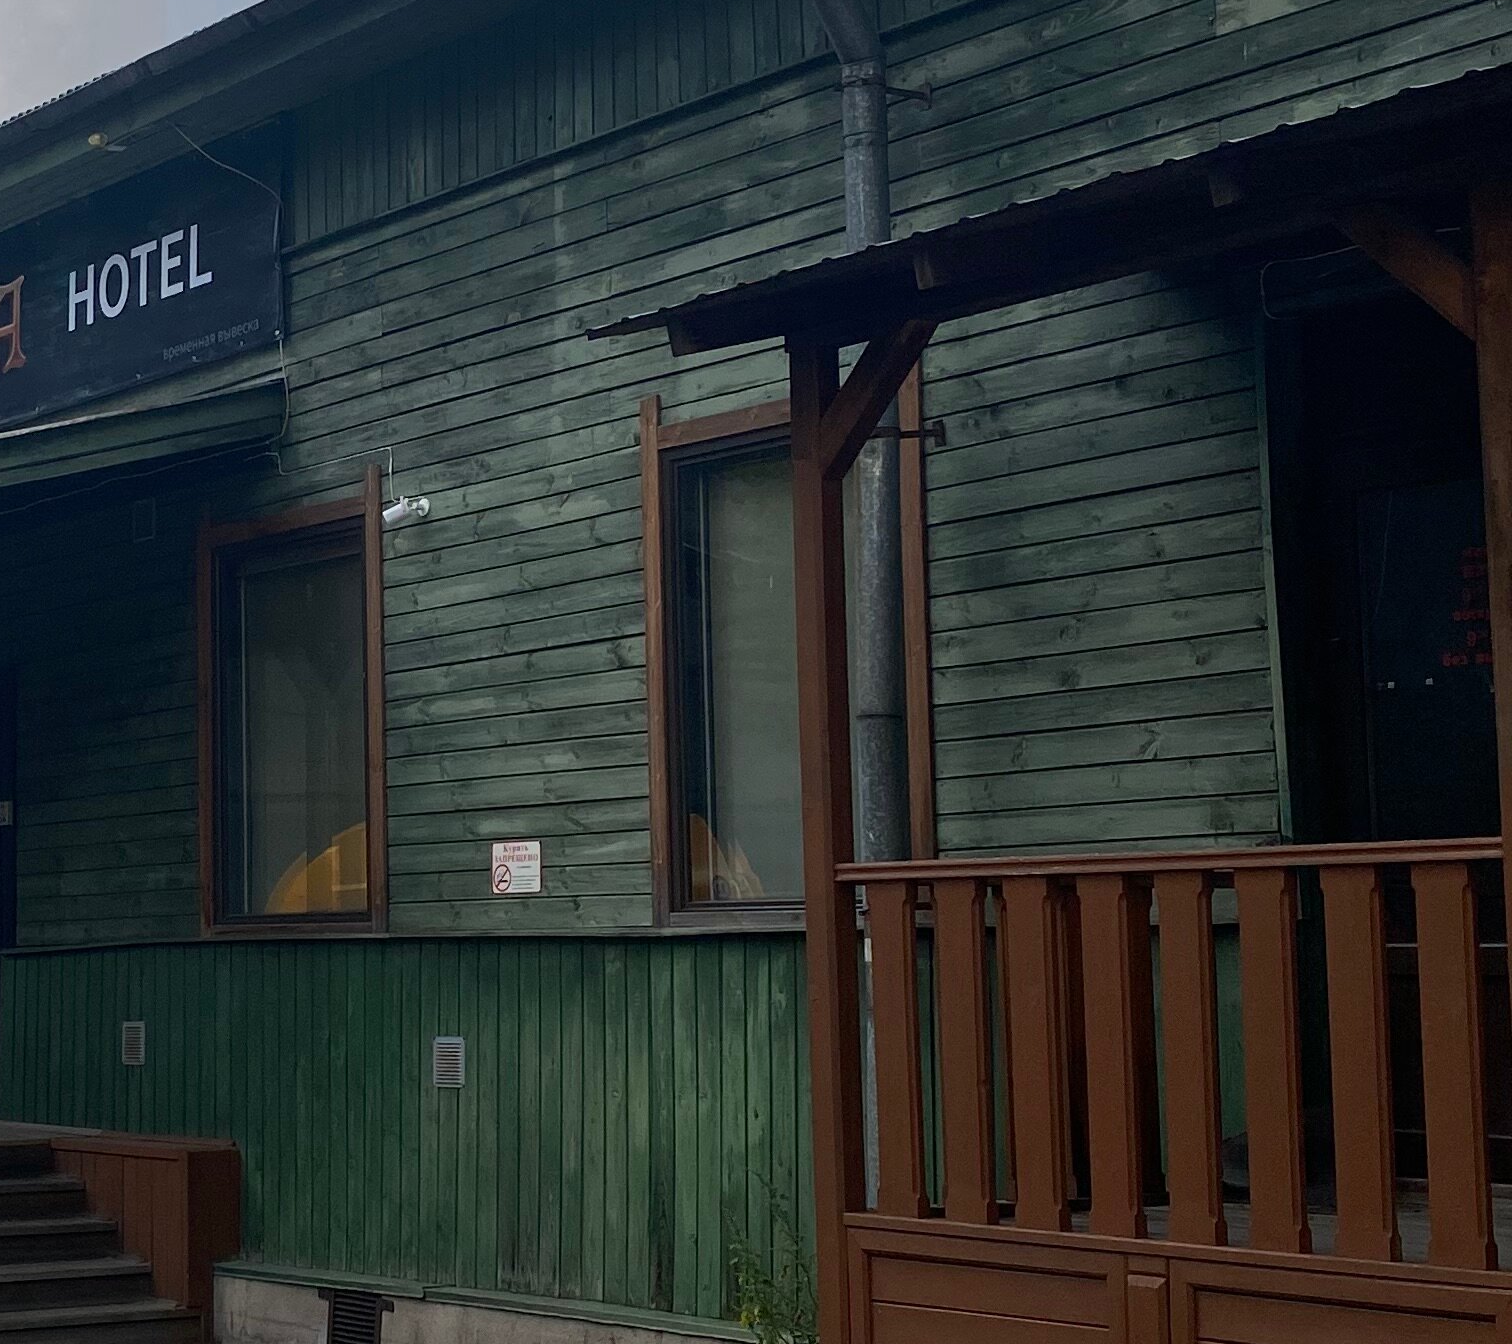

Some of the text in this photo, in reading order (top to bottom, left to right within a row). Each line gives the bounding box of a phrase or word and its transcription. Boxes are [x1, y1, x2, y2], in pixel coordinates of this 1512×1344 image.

[68, 224, 212, 332] HOTEL
[163, 318, 259, 362] временная вывеска
